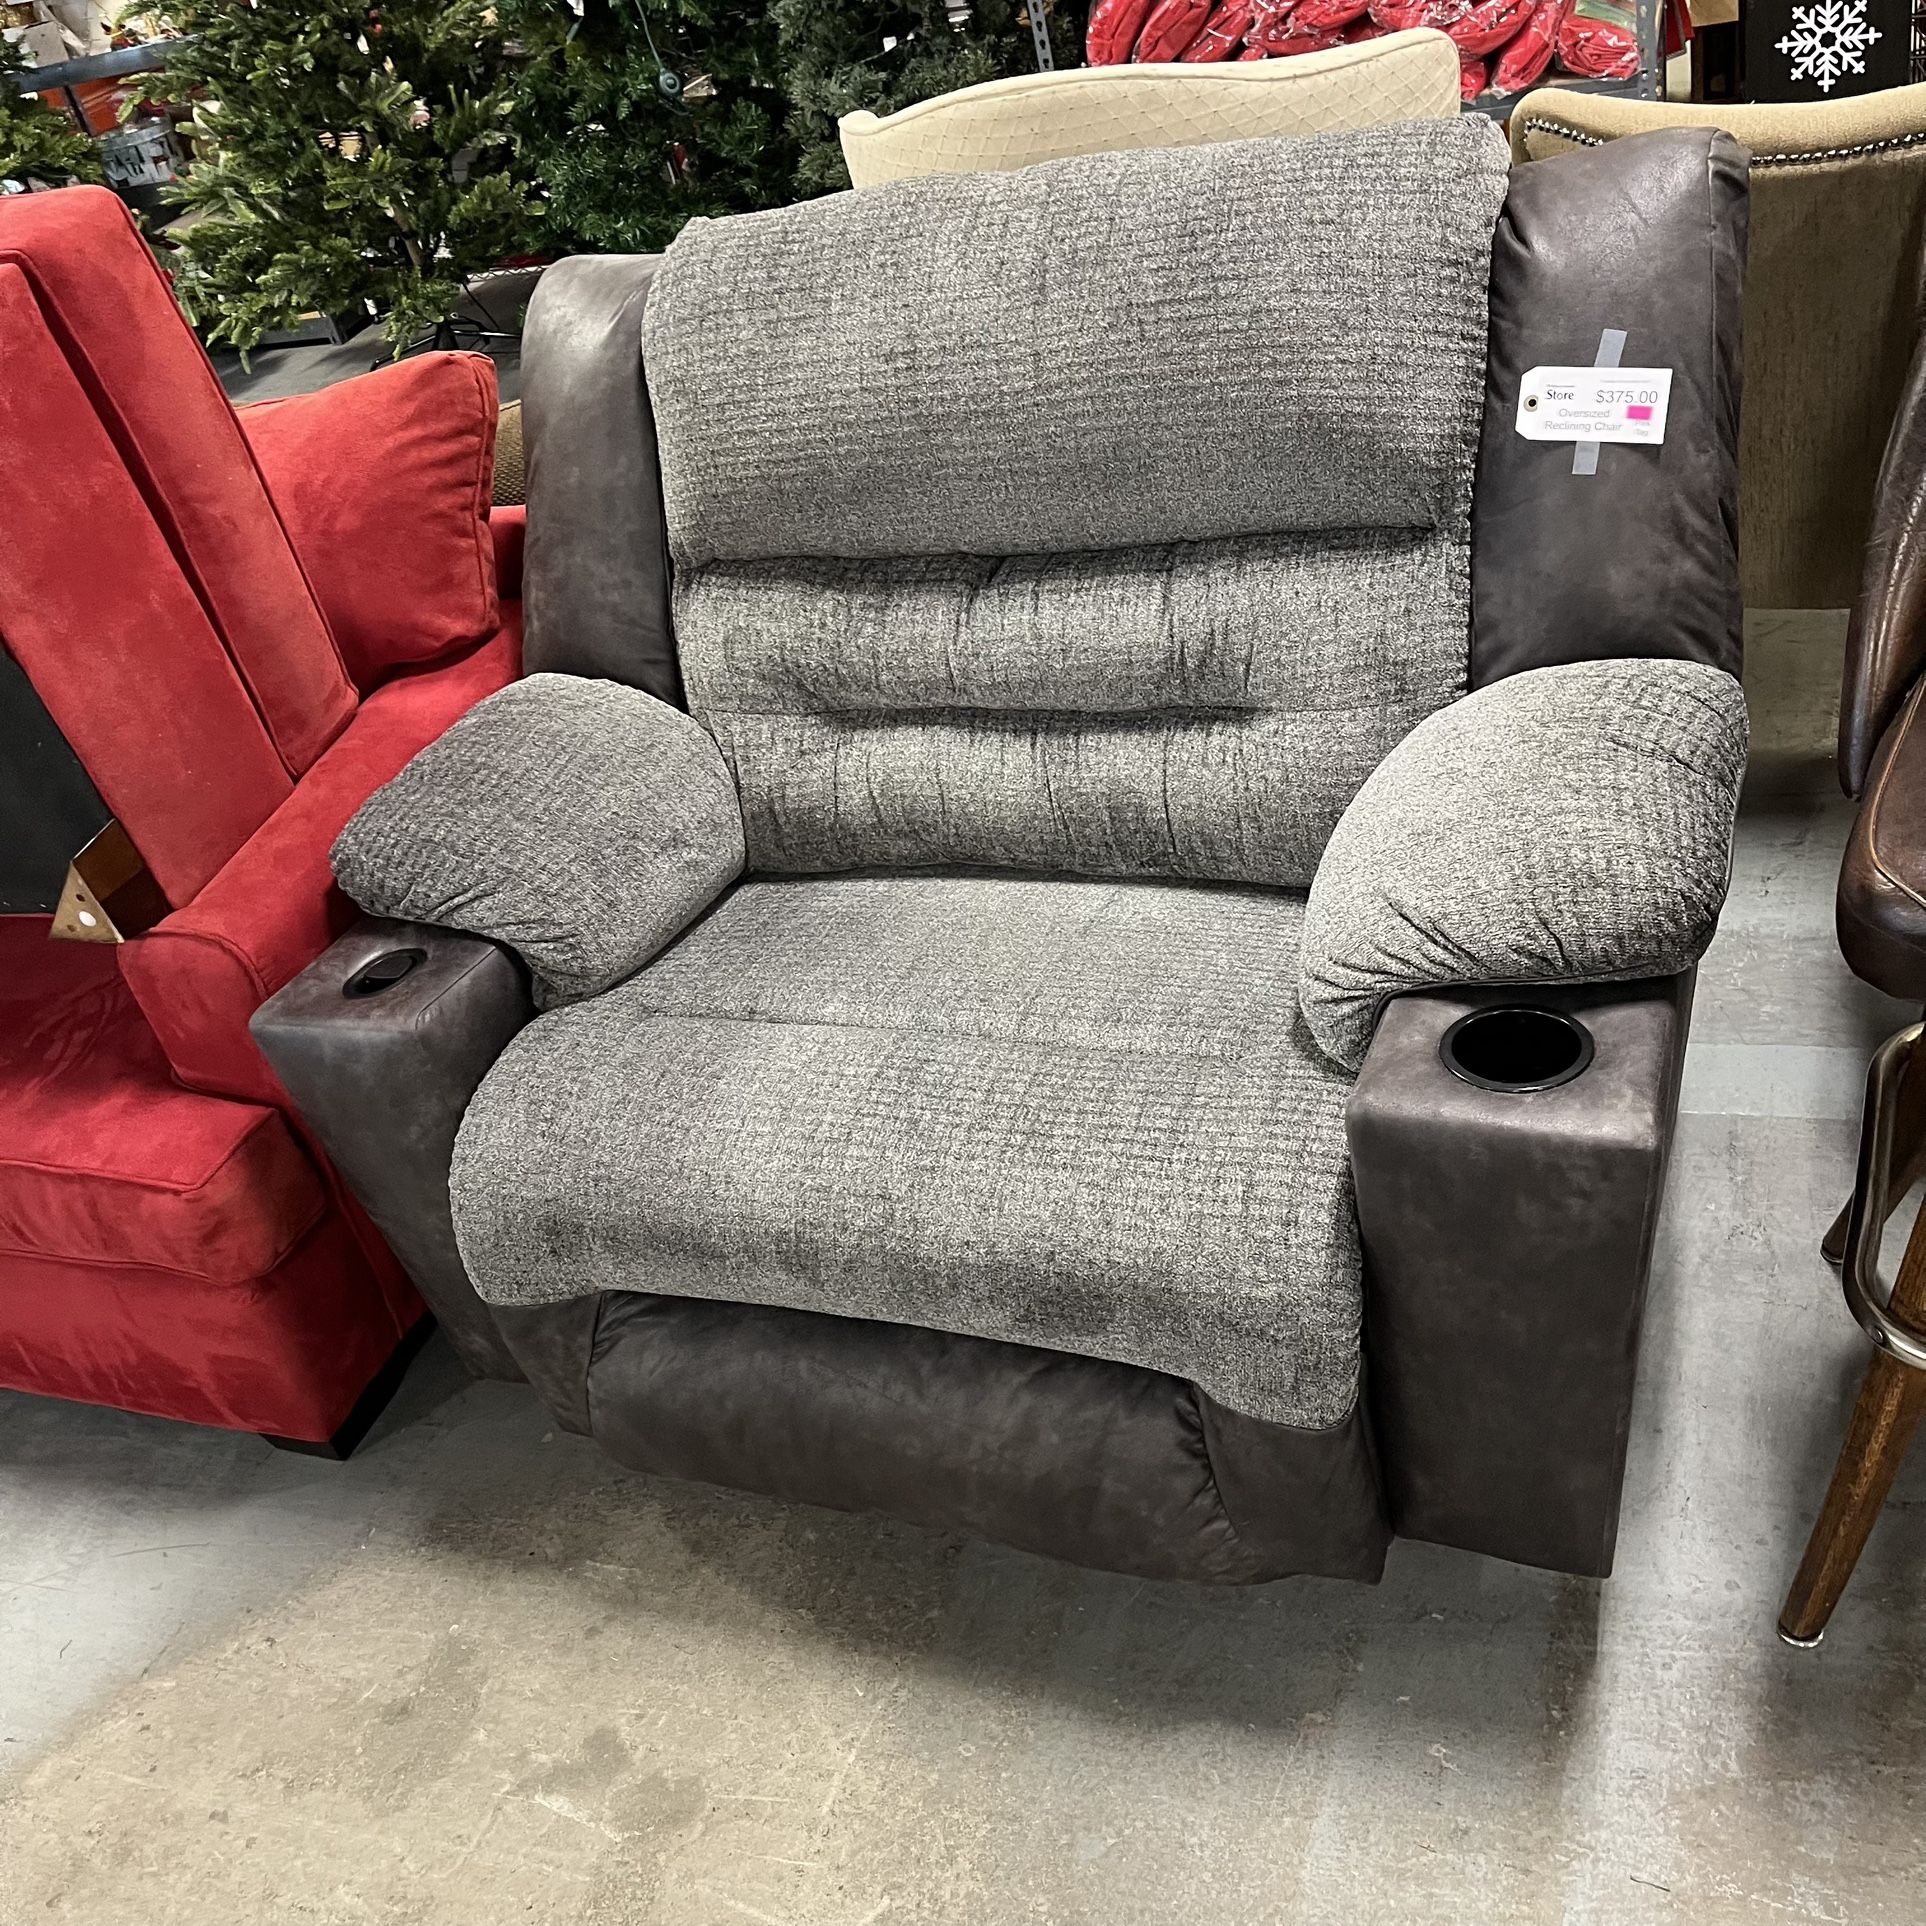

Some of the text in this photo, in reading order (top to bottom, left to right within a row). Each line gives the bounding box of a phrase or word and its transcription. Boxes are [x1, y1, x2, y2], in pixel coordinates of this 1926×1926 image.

[1546, 389, 1574, 400] Store
[1596, 390, 1658, 404] $375.00
[1558, 408, 1611, 418] Oversized
[1544, 420, 1591, 433] Reclining
[1594, 421, 1622, 432] Chair
